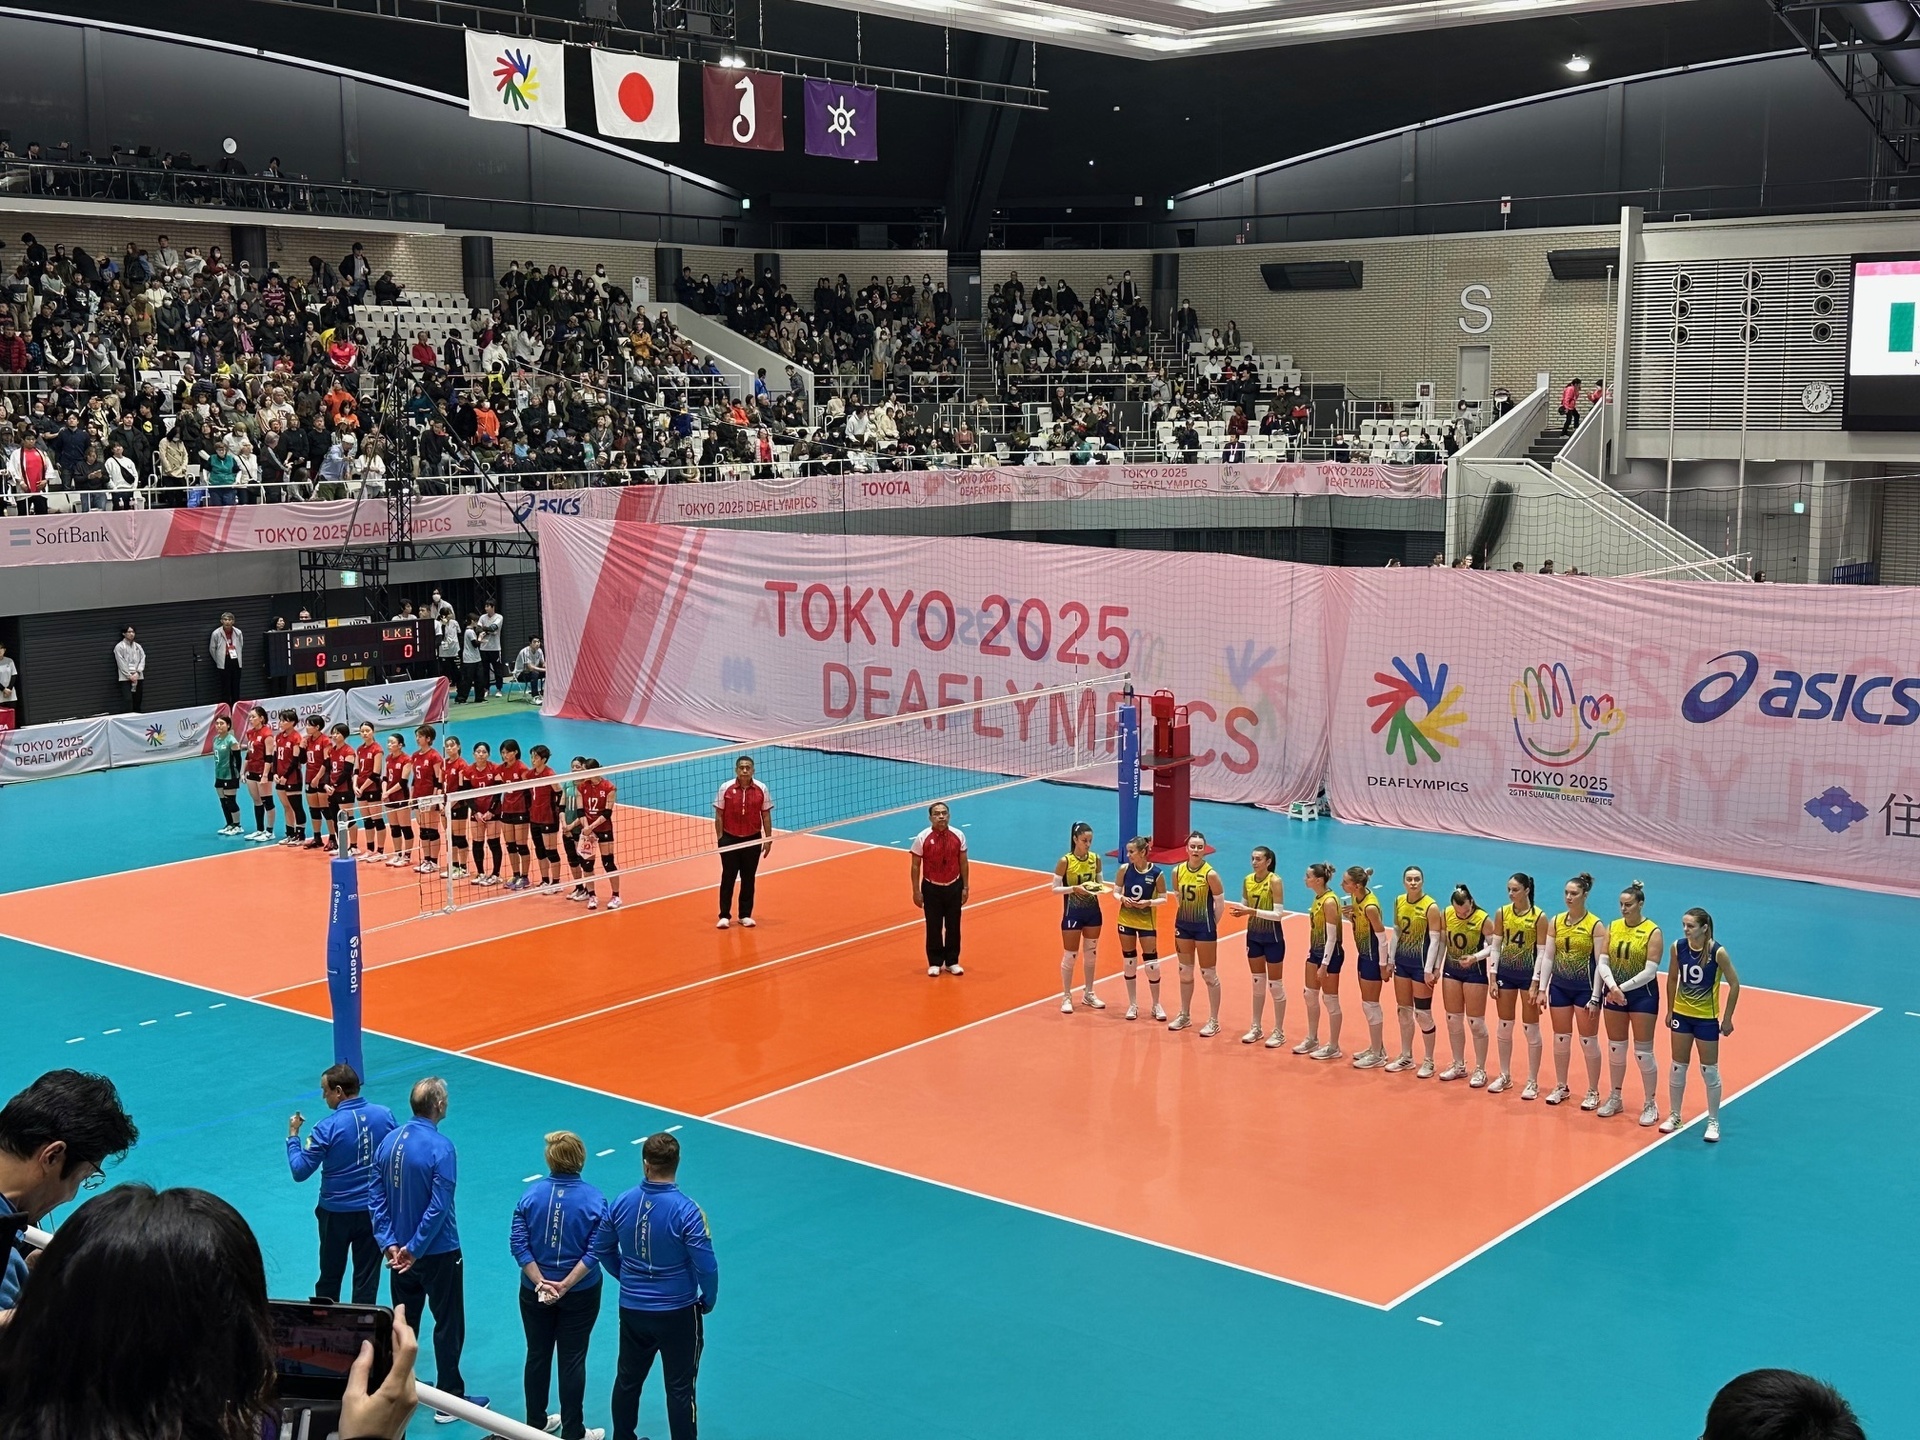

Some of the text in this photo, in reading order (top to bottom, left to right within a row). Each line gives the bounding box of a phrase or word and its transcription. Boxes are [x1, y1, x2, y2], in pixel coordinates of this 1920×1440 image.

[1459, 284, 1493, 334] S
[1121, 468, 1188, 479] TOKYO 2025
[1316, 465, 1374, 477] TOKYO 2025
[862, 481, 911, 496] TOYOTA
[1132, 479, 1208, 490] DEAFLYMPICS
[678, 502, 716, 517] TOKYO
[718, 500, 744, 515] 2025
[746, 496, 818, 513] DEAFLYMPICS
[36, 526, 110, 545] SoftBank
[255, 527, 308, 544] TOKYO
[312, 524, 349, 541] 2025
[352, 517, 452, 538] DEAFLMPICS
[382, 627, 414, 639] UKR
[764, 580, 955, 651] TOKYO
[980, 594, 1130, 669] 2025
[294, 635, 326, 648] JPN
[316, 652, 326, 668] 0
[404, 644, 413, 658] 0
[300, 703, 323, 716] 2025
[14, 735, 84, 754] TOKYO 2025
[15, 746, 94, 767] DEAFLYMPICS
[1367, 776, 1469, 793] DEAFLYMPICS
[1511, 768, 1608, 791] TOKYO 2025
[588, 797, 599, 812] 12
[1509, 788, 1613, 806] 25TH SUMMER DEAFLYMPICS
[1130, 884, 1143, 901] 9
[1181, 884, 1197, 902] 15
[1252, 895, 1261, 909] 7
[1402, 916, 1411, 935] 2
[1448, 931, 1467, 950] 10
[1505, 928, 1526, 948] 14
[1564, 937, 1571, 953] 1
[1616, 941, 1631, 960] 11
[350, 948, 358, 994] Senoh
[1683, 963, 1704, 985] 19
